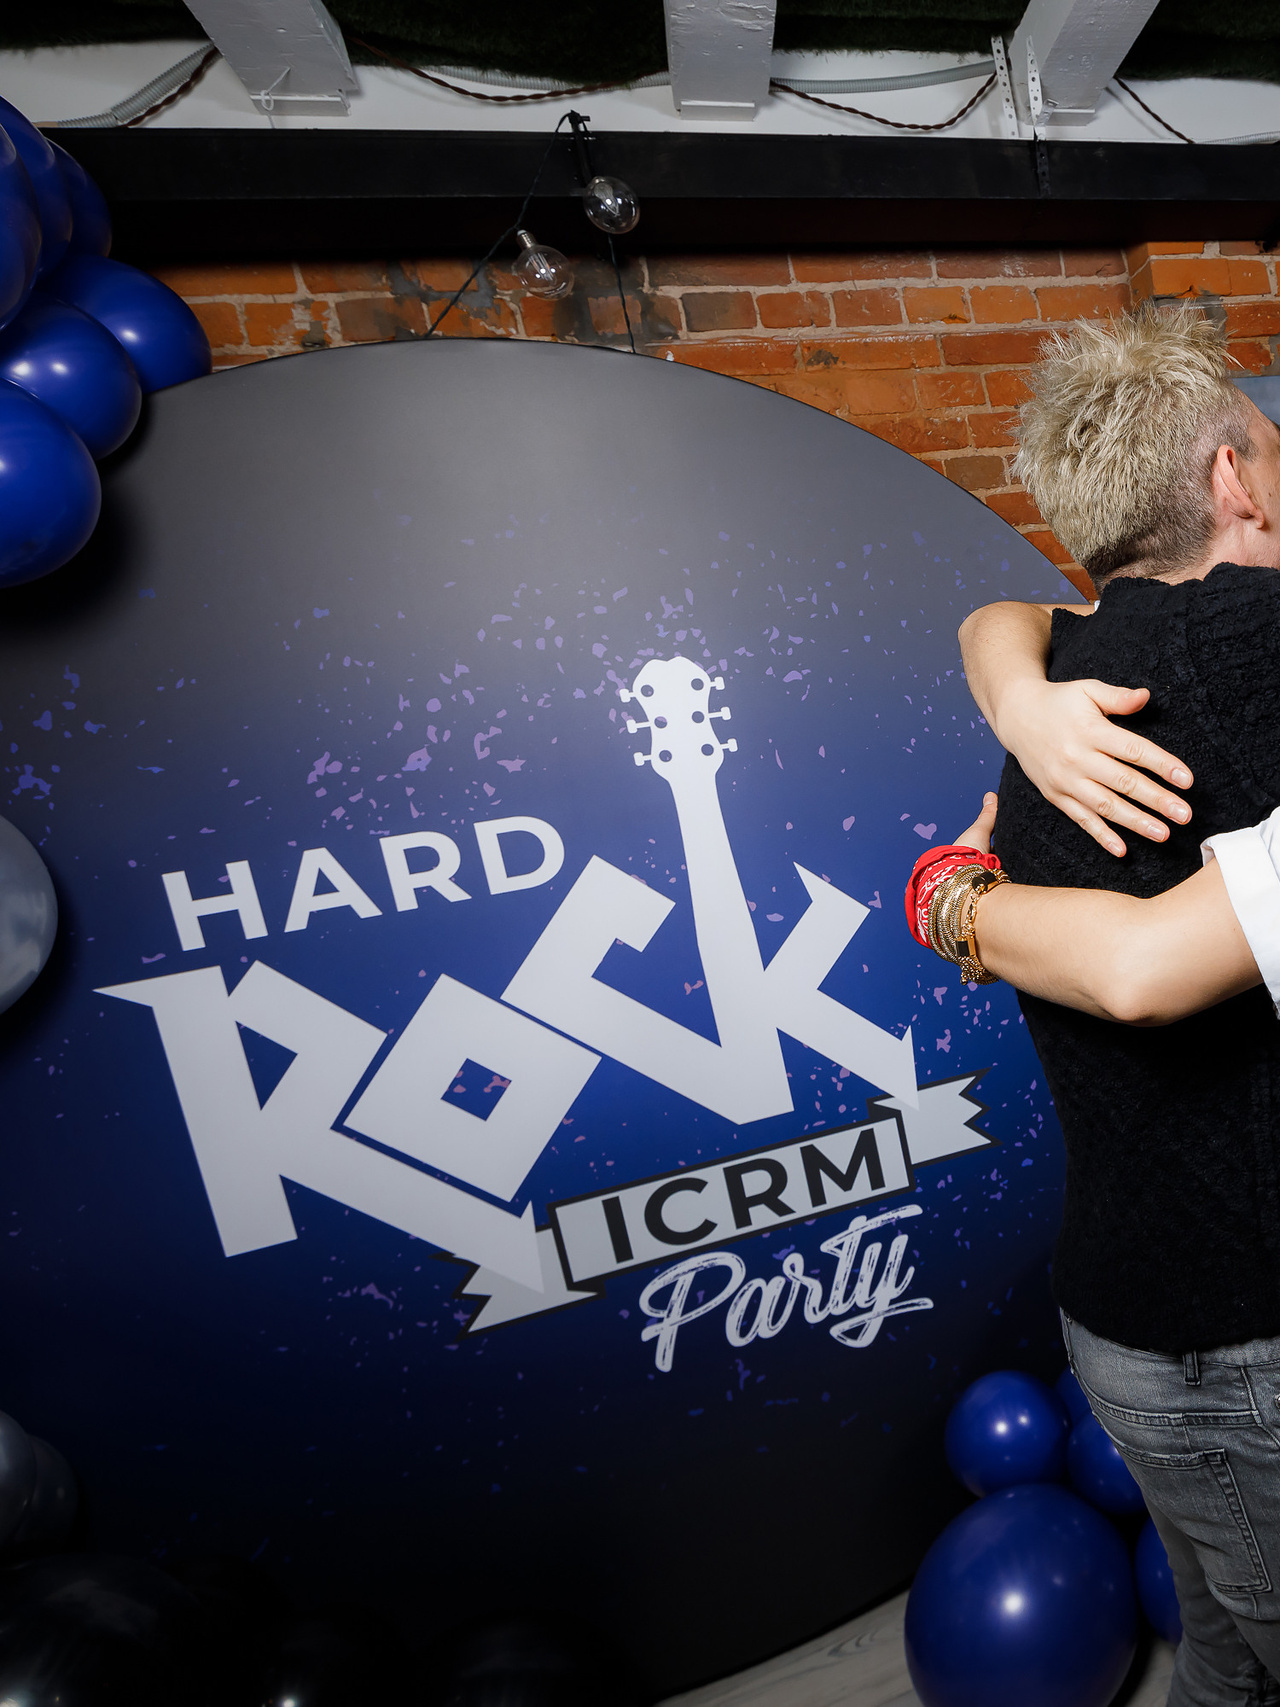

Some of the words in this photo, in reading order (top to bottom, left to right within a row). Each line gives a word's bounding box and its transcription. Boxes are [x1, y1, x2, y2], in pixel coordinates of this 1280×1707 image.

[163, 816, 565, 951] HARD
[602, 1127, 886, 1262] ICRM
[641, 1204, 933, 1372] Party
